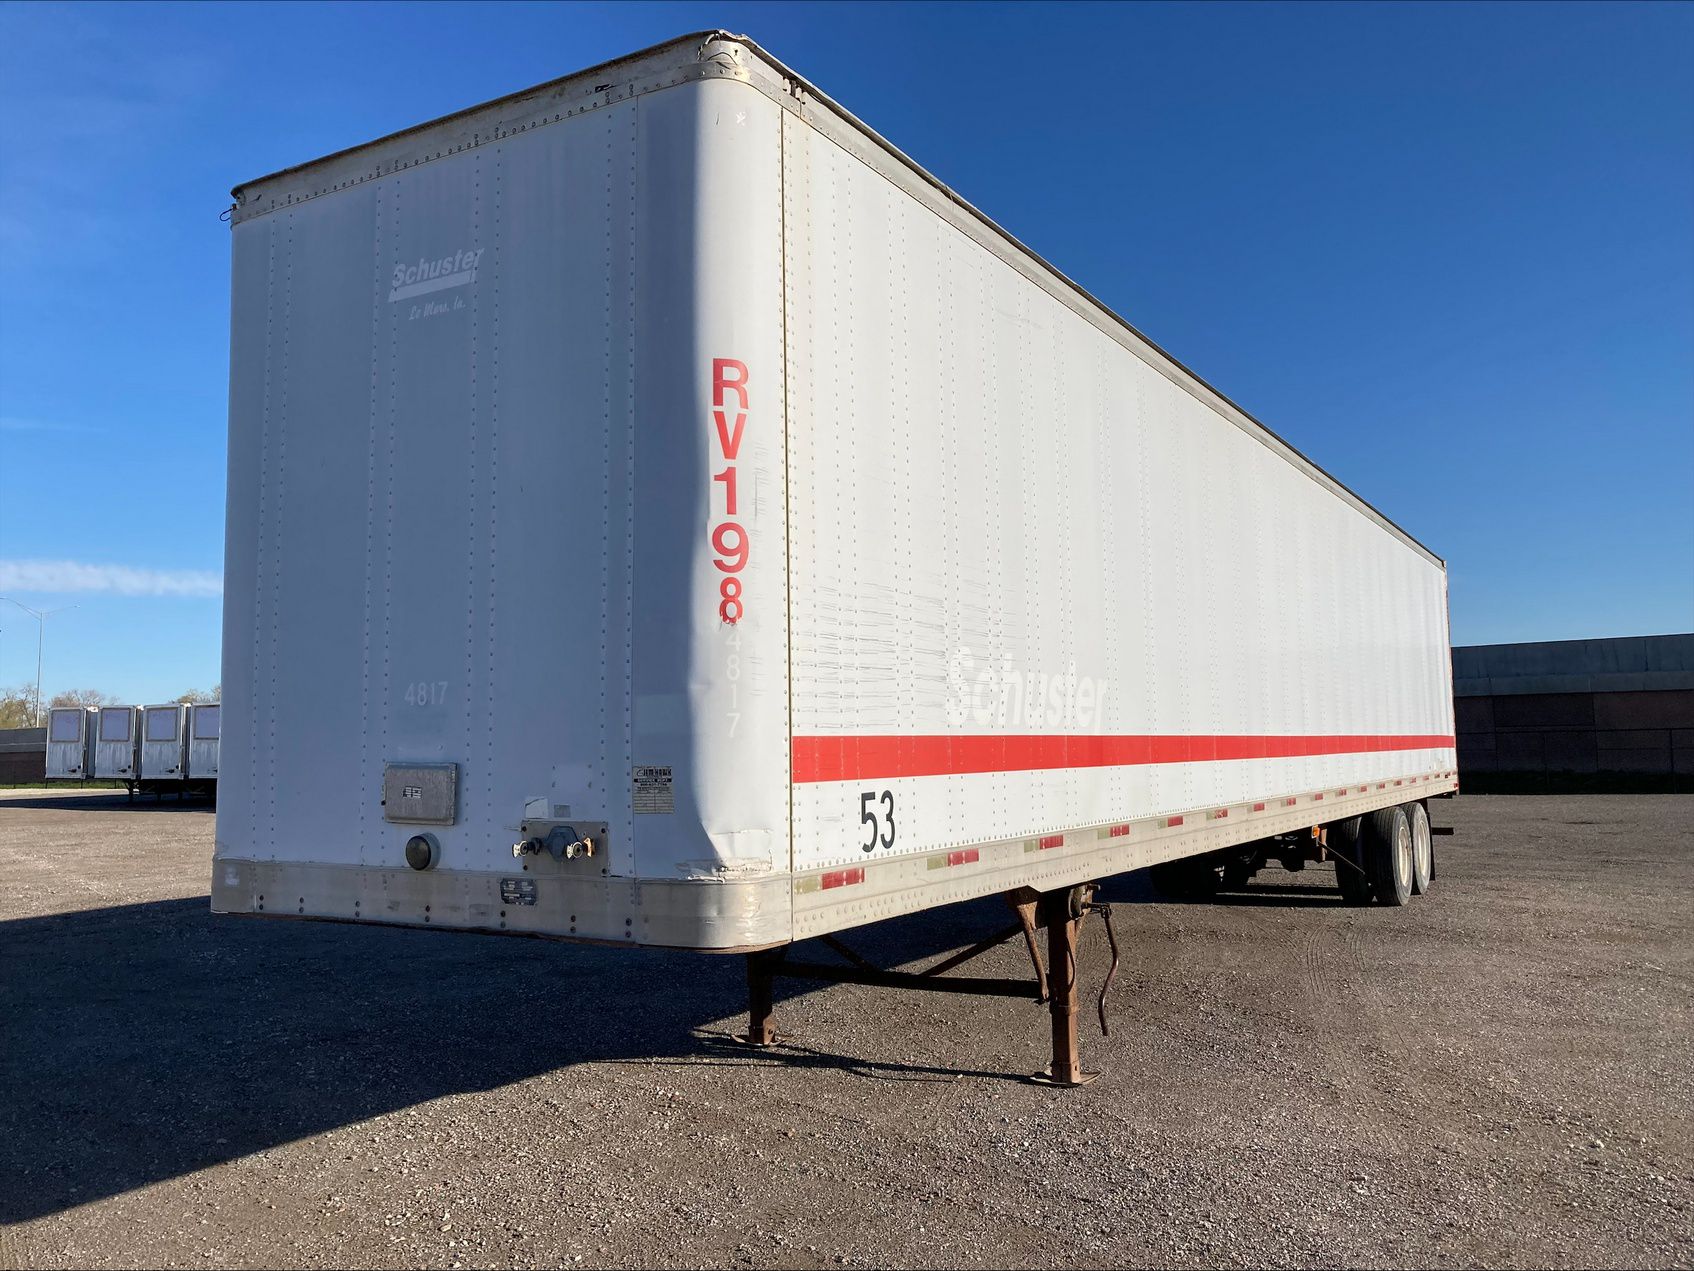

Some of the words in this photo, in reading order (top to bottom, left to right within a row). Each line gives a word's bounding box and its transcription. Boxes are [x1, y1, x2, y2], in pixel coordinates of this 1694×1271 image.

[392, 247, 485, 288] Schuster
[711, 358, 750, 624] RV198
[404, 680, 449, 706] 4817
[724, 629, 742, 739] 4817
[944, 645, 1108, 730] Schuster
[860, 789, 896, 853] 53
